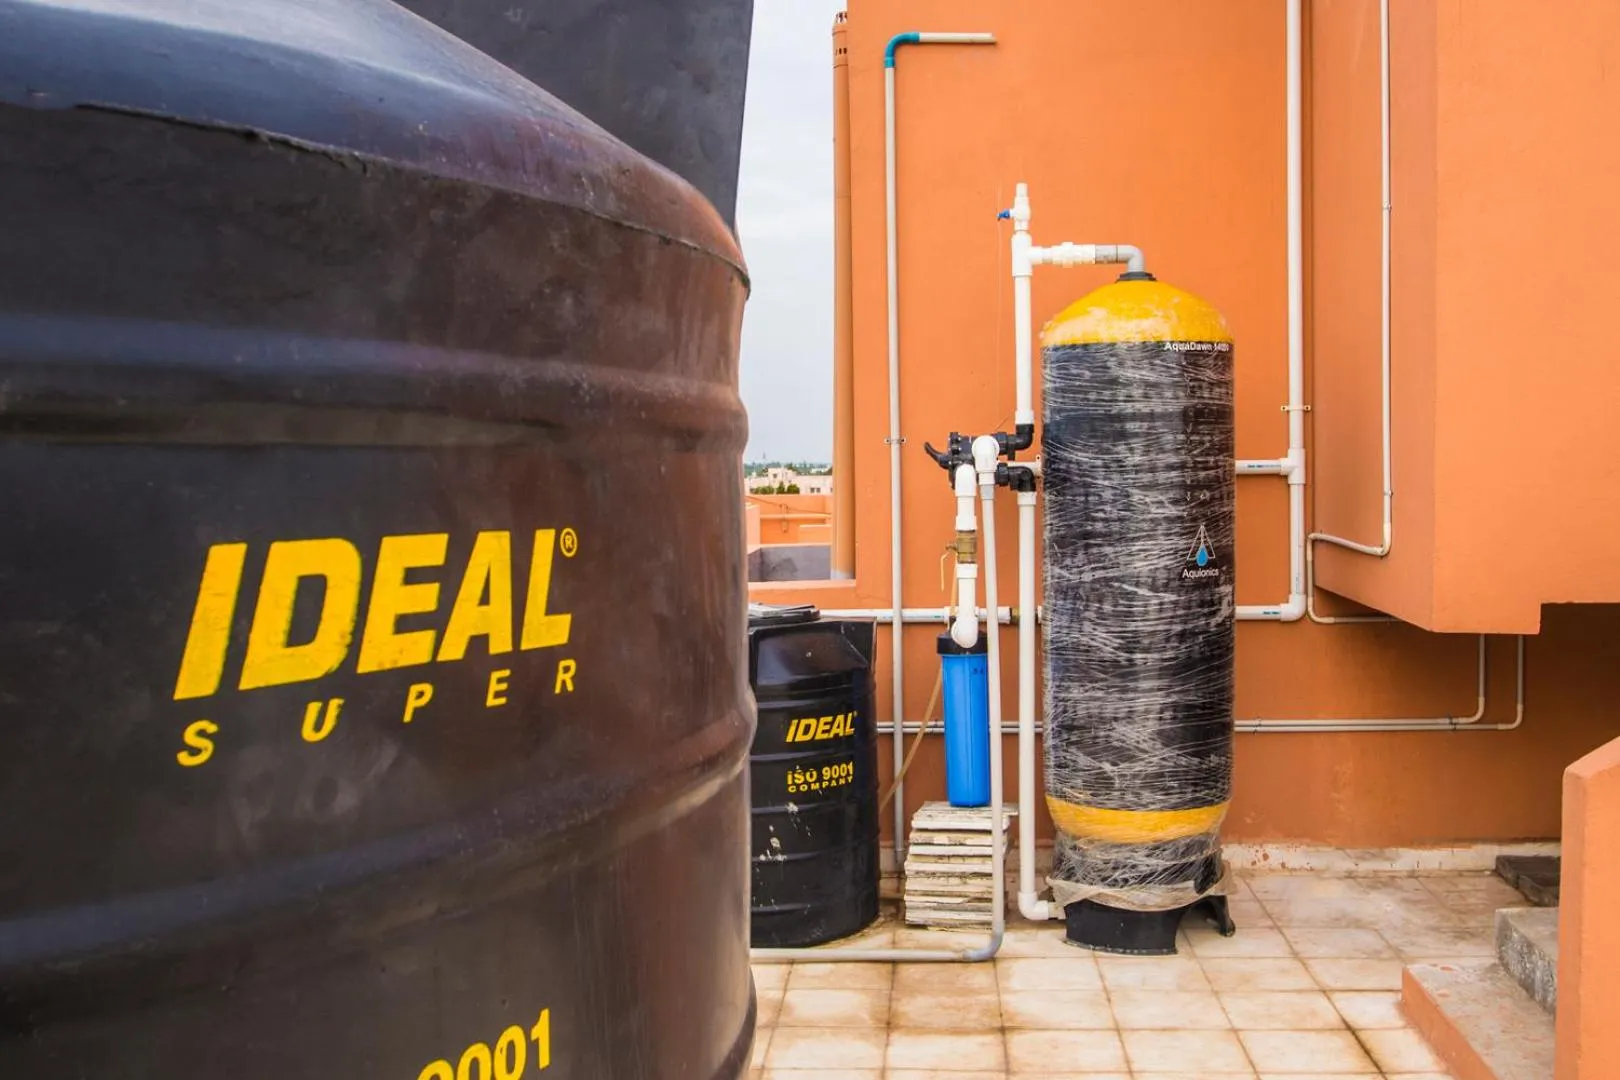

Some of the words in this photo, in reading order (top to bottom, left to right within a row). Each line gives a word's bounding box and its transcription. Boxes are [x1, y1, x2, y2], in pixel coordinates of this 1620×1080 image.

[1182, 568, 1220, 579] Aquionics
[176, 658, 577, 767] SUPER
[787, 769, 818, 785] ISO
[822, 761, 854, 781] 9001
[787, 775, 854, 793] COMPANY
